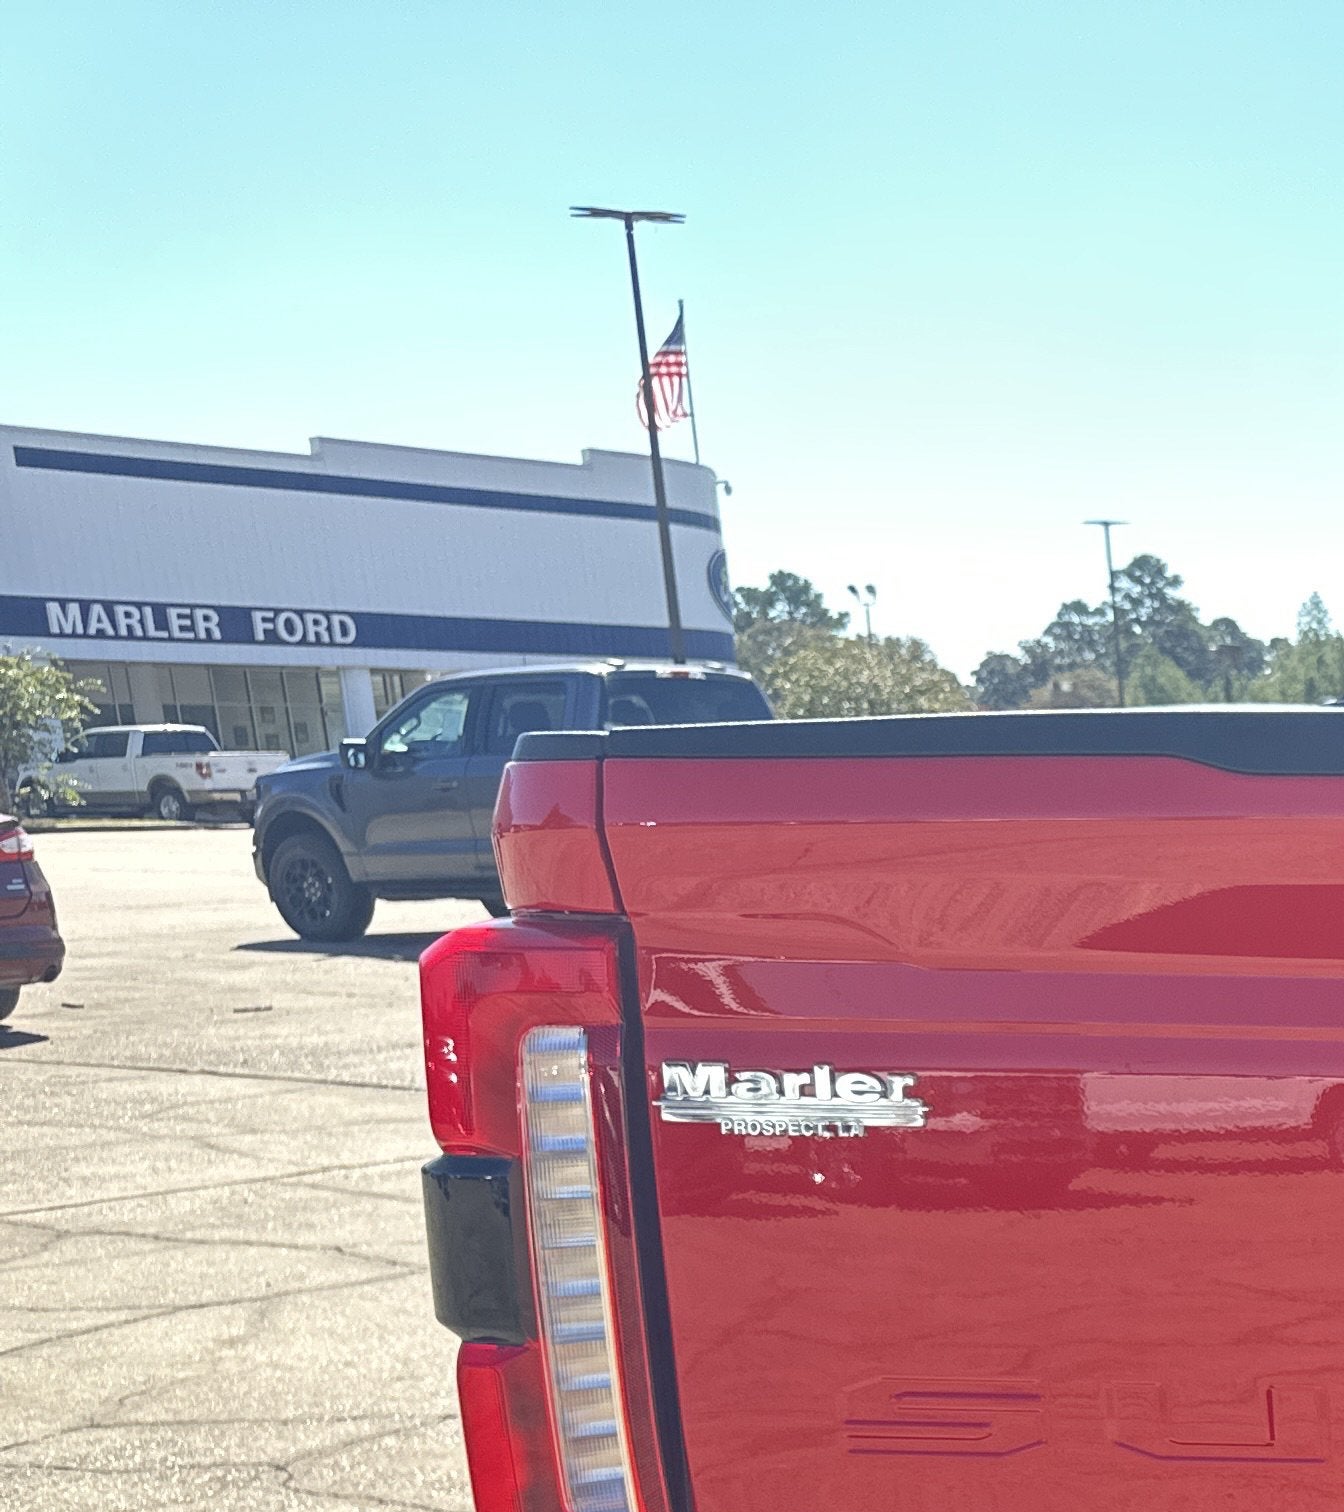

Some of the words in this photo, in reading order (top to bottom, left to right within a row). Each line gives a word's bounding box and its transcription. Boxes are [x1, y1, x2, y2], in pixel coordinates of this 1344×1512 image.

[46, 601, 222, 640] MARLER
[250, 610, 357, 646] FORD
[660, 1061, 915, 1103] Marler
[720, 1119, 831, 1139] PROSPECT,
[837, 1120, 866, 1138] LA
